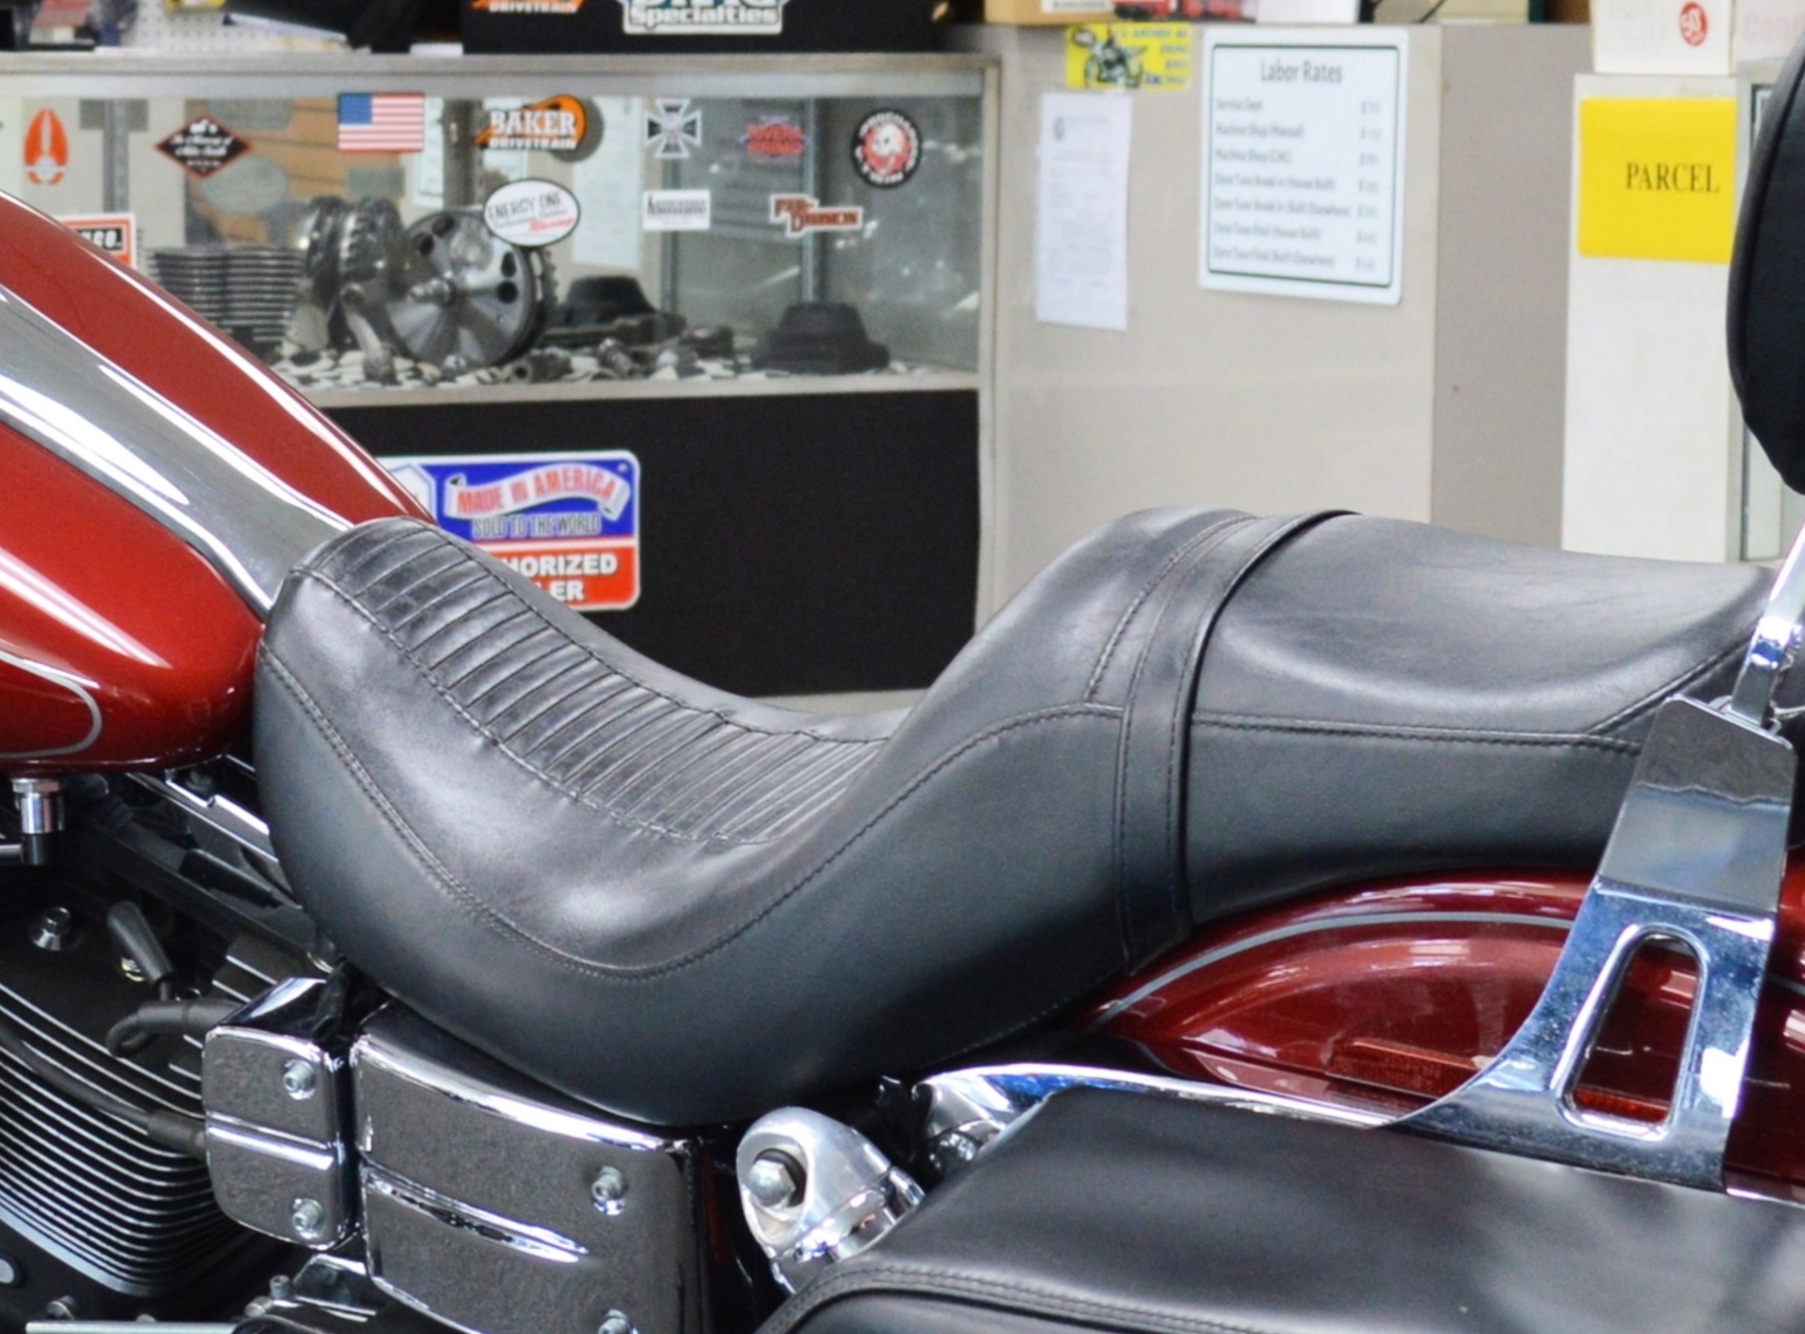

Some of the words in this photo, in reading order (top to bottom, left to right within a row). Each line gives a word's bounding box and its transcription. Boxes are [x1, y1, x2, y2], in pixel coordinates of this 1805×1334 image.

[488, 0, 579, 14] DRIVETRAIN
[629, 4, 778, 29] Specialties
[1260, 58, 1299, 83] Labor
[1302, 61, 1344, 83] Rates
[489, 110, 577, 136] BAKER
[1626, 161, 1720, 192] PARCEL
[485, 196, 536, 219] ENERGY
[457, 487, 504, 515] MADE
[510, 479, 530, 503] IN
[532, 467, 617, 503] AMERICA
[474, 518, 510, 538] SOLD
[511, 517, 527, 536] TO
[531, 516, 556, 536] THE
[557, 515, 601, 535] WORLD
[504, 553, 619, 576] HORIZED
